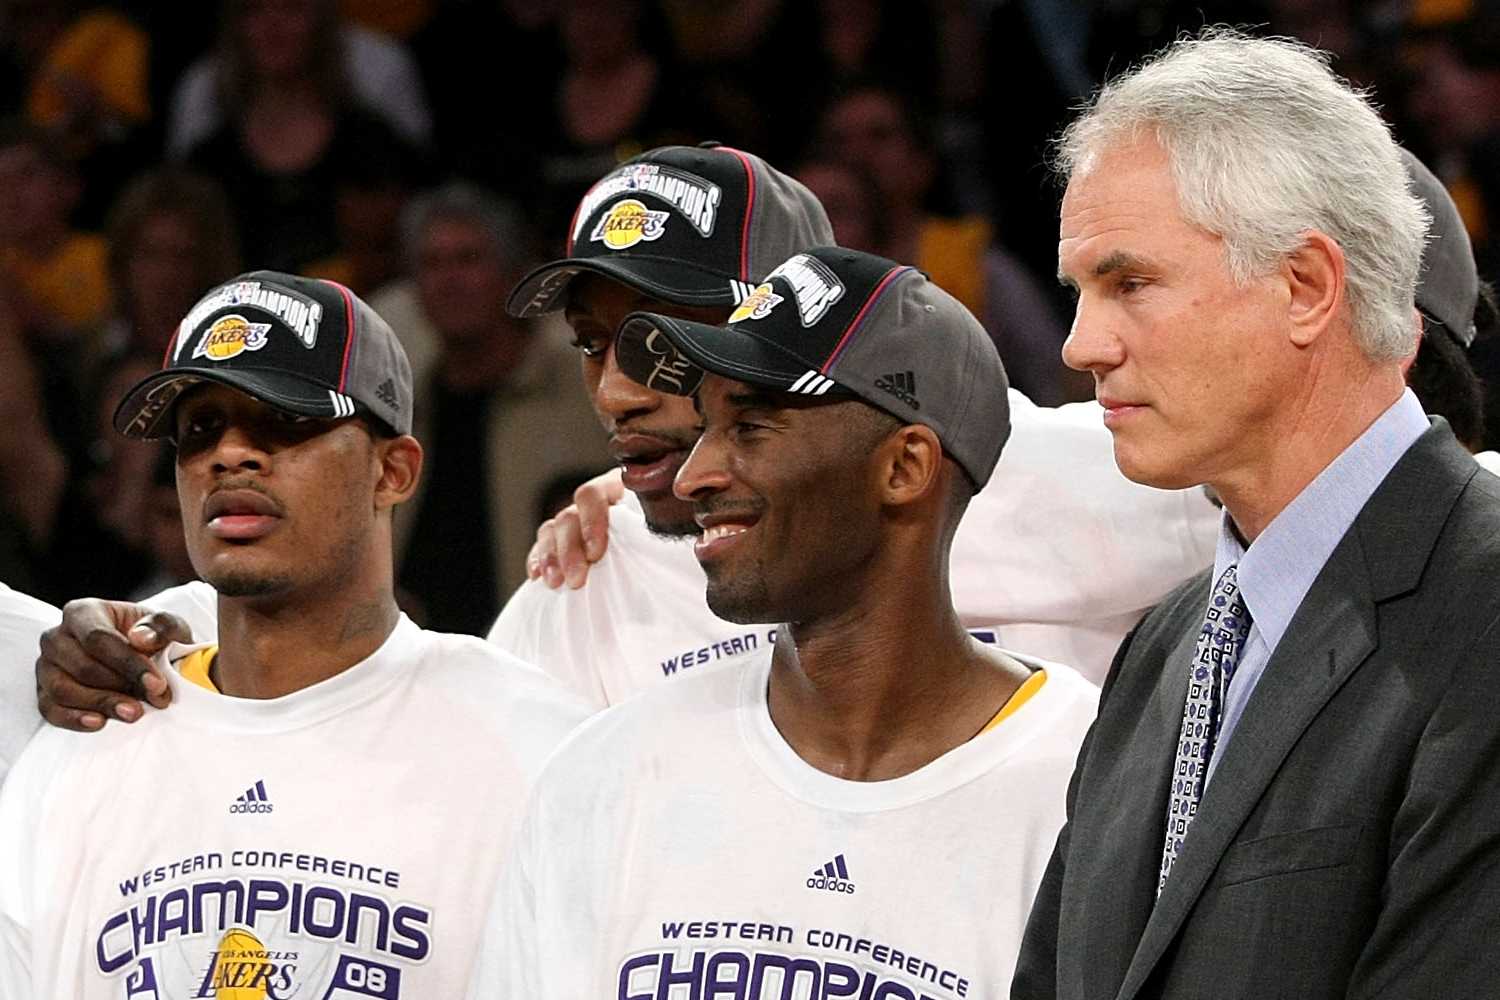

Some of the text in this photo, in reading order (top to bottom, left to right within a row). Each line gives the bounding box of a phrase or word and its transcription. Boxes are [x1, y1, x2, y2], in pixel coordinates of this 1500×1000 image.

[640, 176, 718, 233] CHAMPIONS
[598, 214, 665, 237] LAKERS
[242, 286, 320, 345] CHAMPIONS
[201, 328, 265, 351] LAKERS
[874, 379, 920, 410] adidas
[661, 633, 757, 676] WESTERN
[229, 800, 274, 814] adidas
[119, 851, 401, 897] WESTERN CONFERENCE
[806, 875, 856, 895] adidas
[96, 879, 430, 974] CHAMPIONS
[239, 950, 300, 961] ANGELES
[662, 922, 970, 998] WESTERN CONFERENCE
[345, 962, 387, 992] 08
